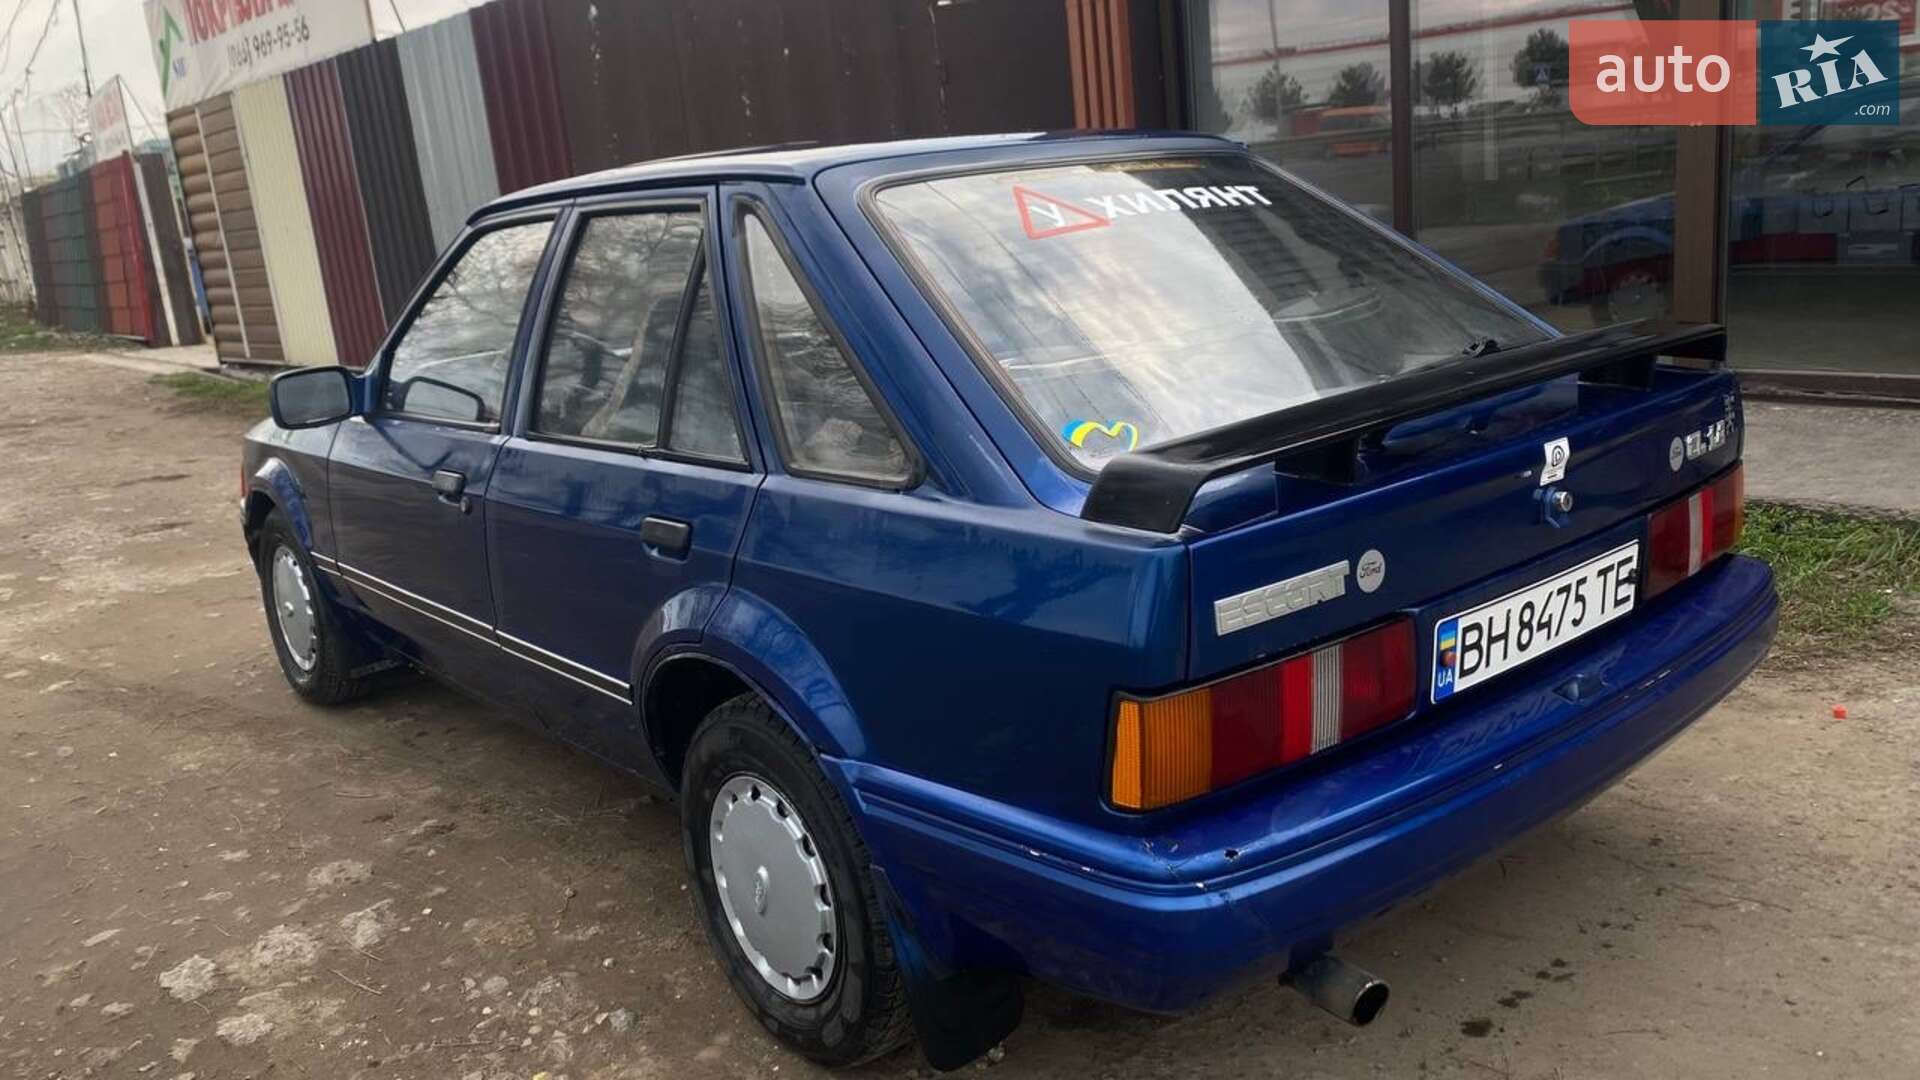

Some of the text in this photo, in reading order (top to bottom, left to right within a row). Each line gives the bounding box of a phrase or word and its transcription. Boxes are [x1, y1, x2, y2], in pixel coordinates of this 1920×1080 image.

[1213, 559, 1350, 637] ESCORT
[1517, 576, 1588, 652] 8475
[1438, 669, 1454, 688] UA
